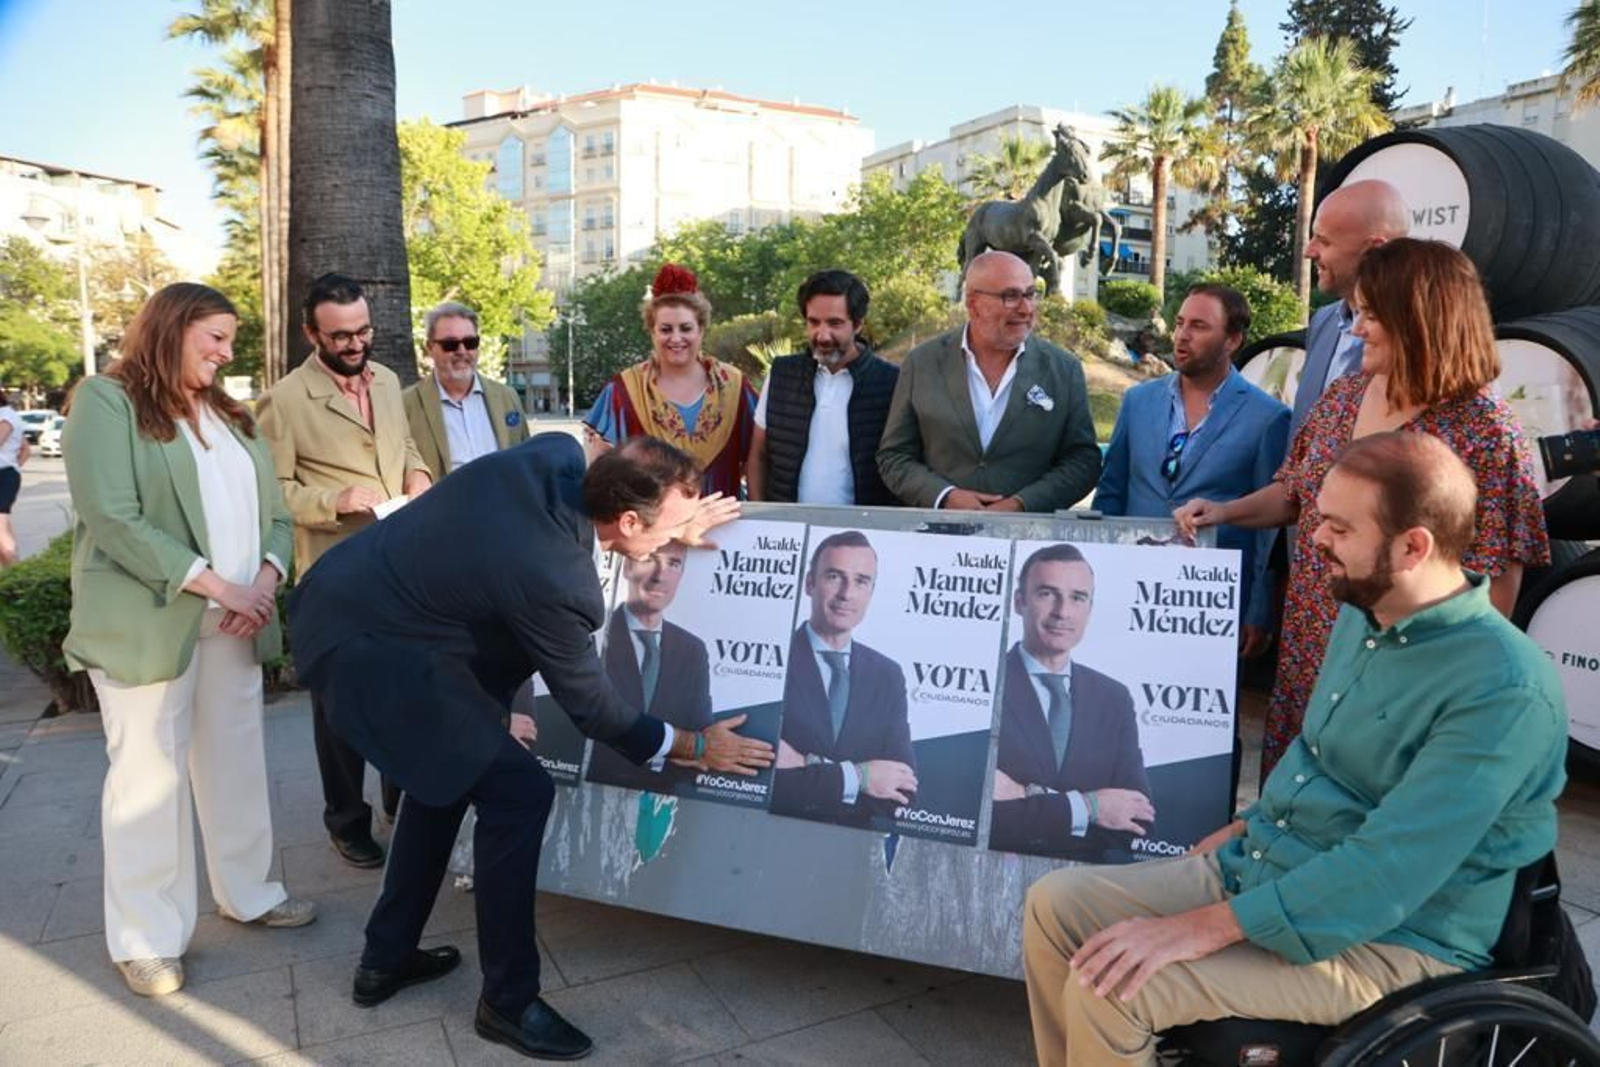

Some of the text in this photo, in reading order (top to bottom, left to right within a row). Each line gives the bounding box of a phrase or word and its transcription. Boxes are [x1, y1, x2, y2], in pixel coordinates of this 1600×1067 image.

[1411, 204, 1460, 226] WIST
[752, 536, 801, 551] Alcalde
[716, 549, 797, 575] Manuel
[951, 551, 1007, 570] Alcalde
[912, 566, 1003, 595] Manuel
[1176, 563, 1238, 583] Alcalde
[709, 572, 794, 600] Méndez
[1134, 580, 1235, 609] Manuel
[904, 591, 1000, 621] Méndez
[1128, 607, 1234, 637] Méndez
[715, 638, 783, 667] VOTA
[1562, 651, 1599, 671] FINO
[720, 665, 782, 680] CIUDADANOS
[913, 661, 990, 693] VOTA
[919, 691, 989, 706] CIUDADANOS
[1141, 683, 1230, 714] VOTA
[1150, 714, 1230, 729] CIUDADANOS
[537, 755, 580, 774] onJerez
[696, 774, 768, 794] #YoConJerez
[894, 807, 976, 830] #YoConJerez
[1130, 838, 1195, 856] #YoCon
